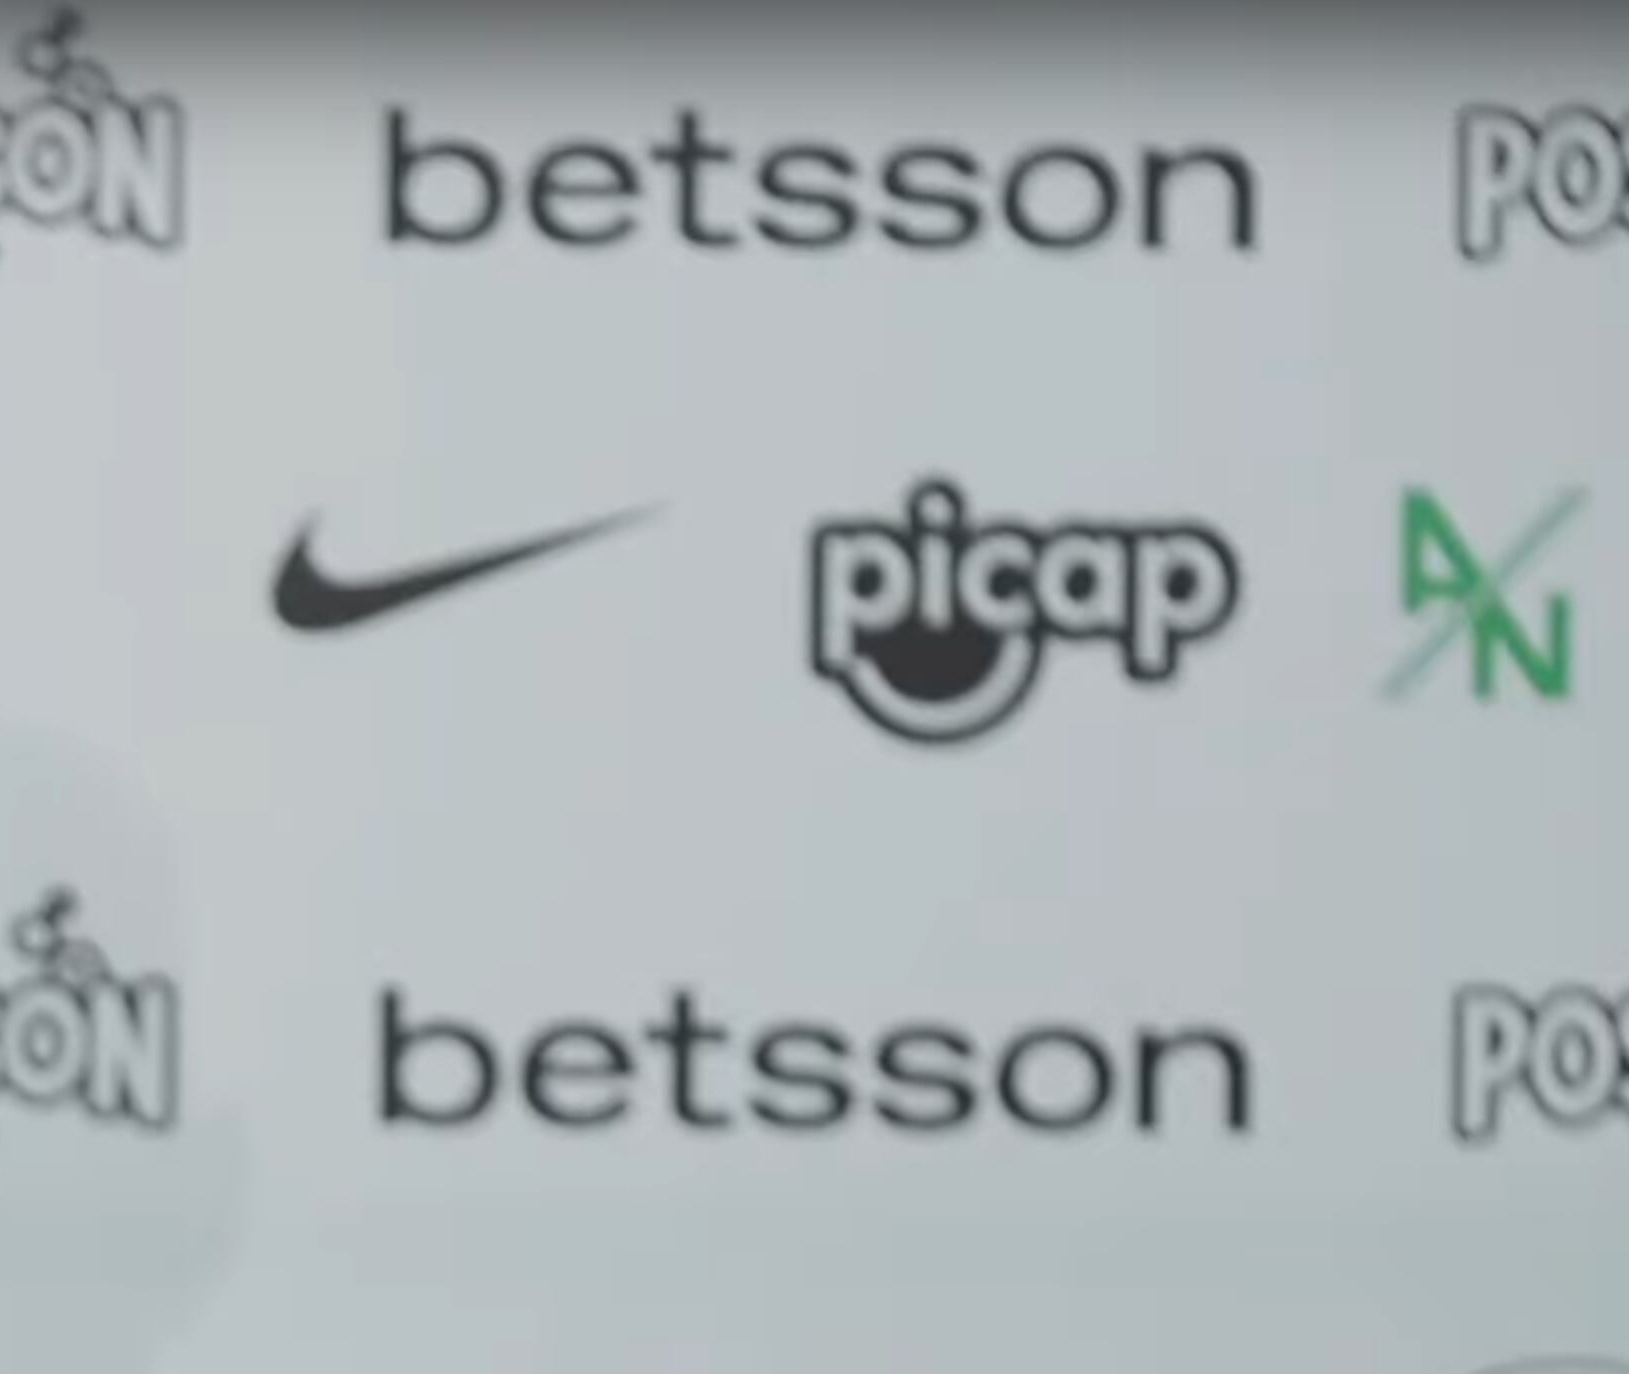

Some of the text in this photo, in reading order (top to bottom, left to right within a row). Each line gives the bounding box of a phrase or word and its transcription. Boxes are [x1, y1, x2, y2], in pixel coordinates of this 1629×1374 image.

[384, 105, 1258, 252] betsson
[1455, 101, 1629, 263] PO
[811, 477, 1243, 683] picap
[378, 988, 1252, 1136] betsson
[1449, 988, 1629, 1146] PO
